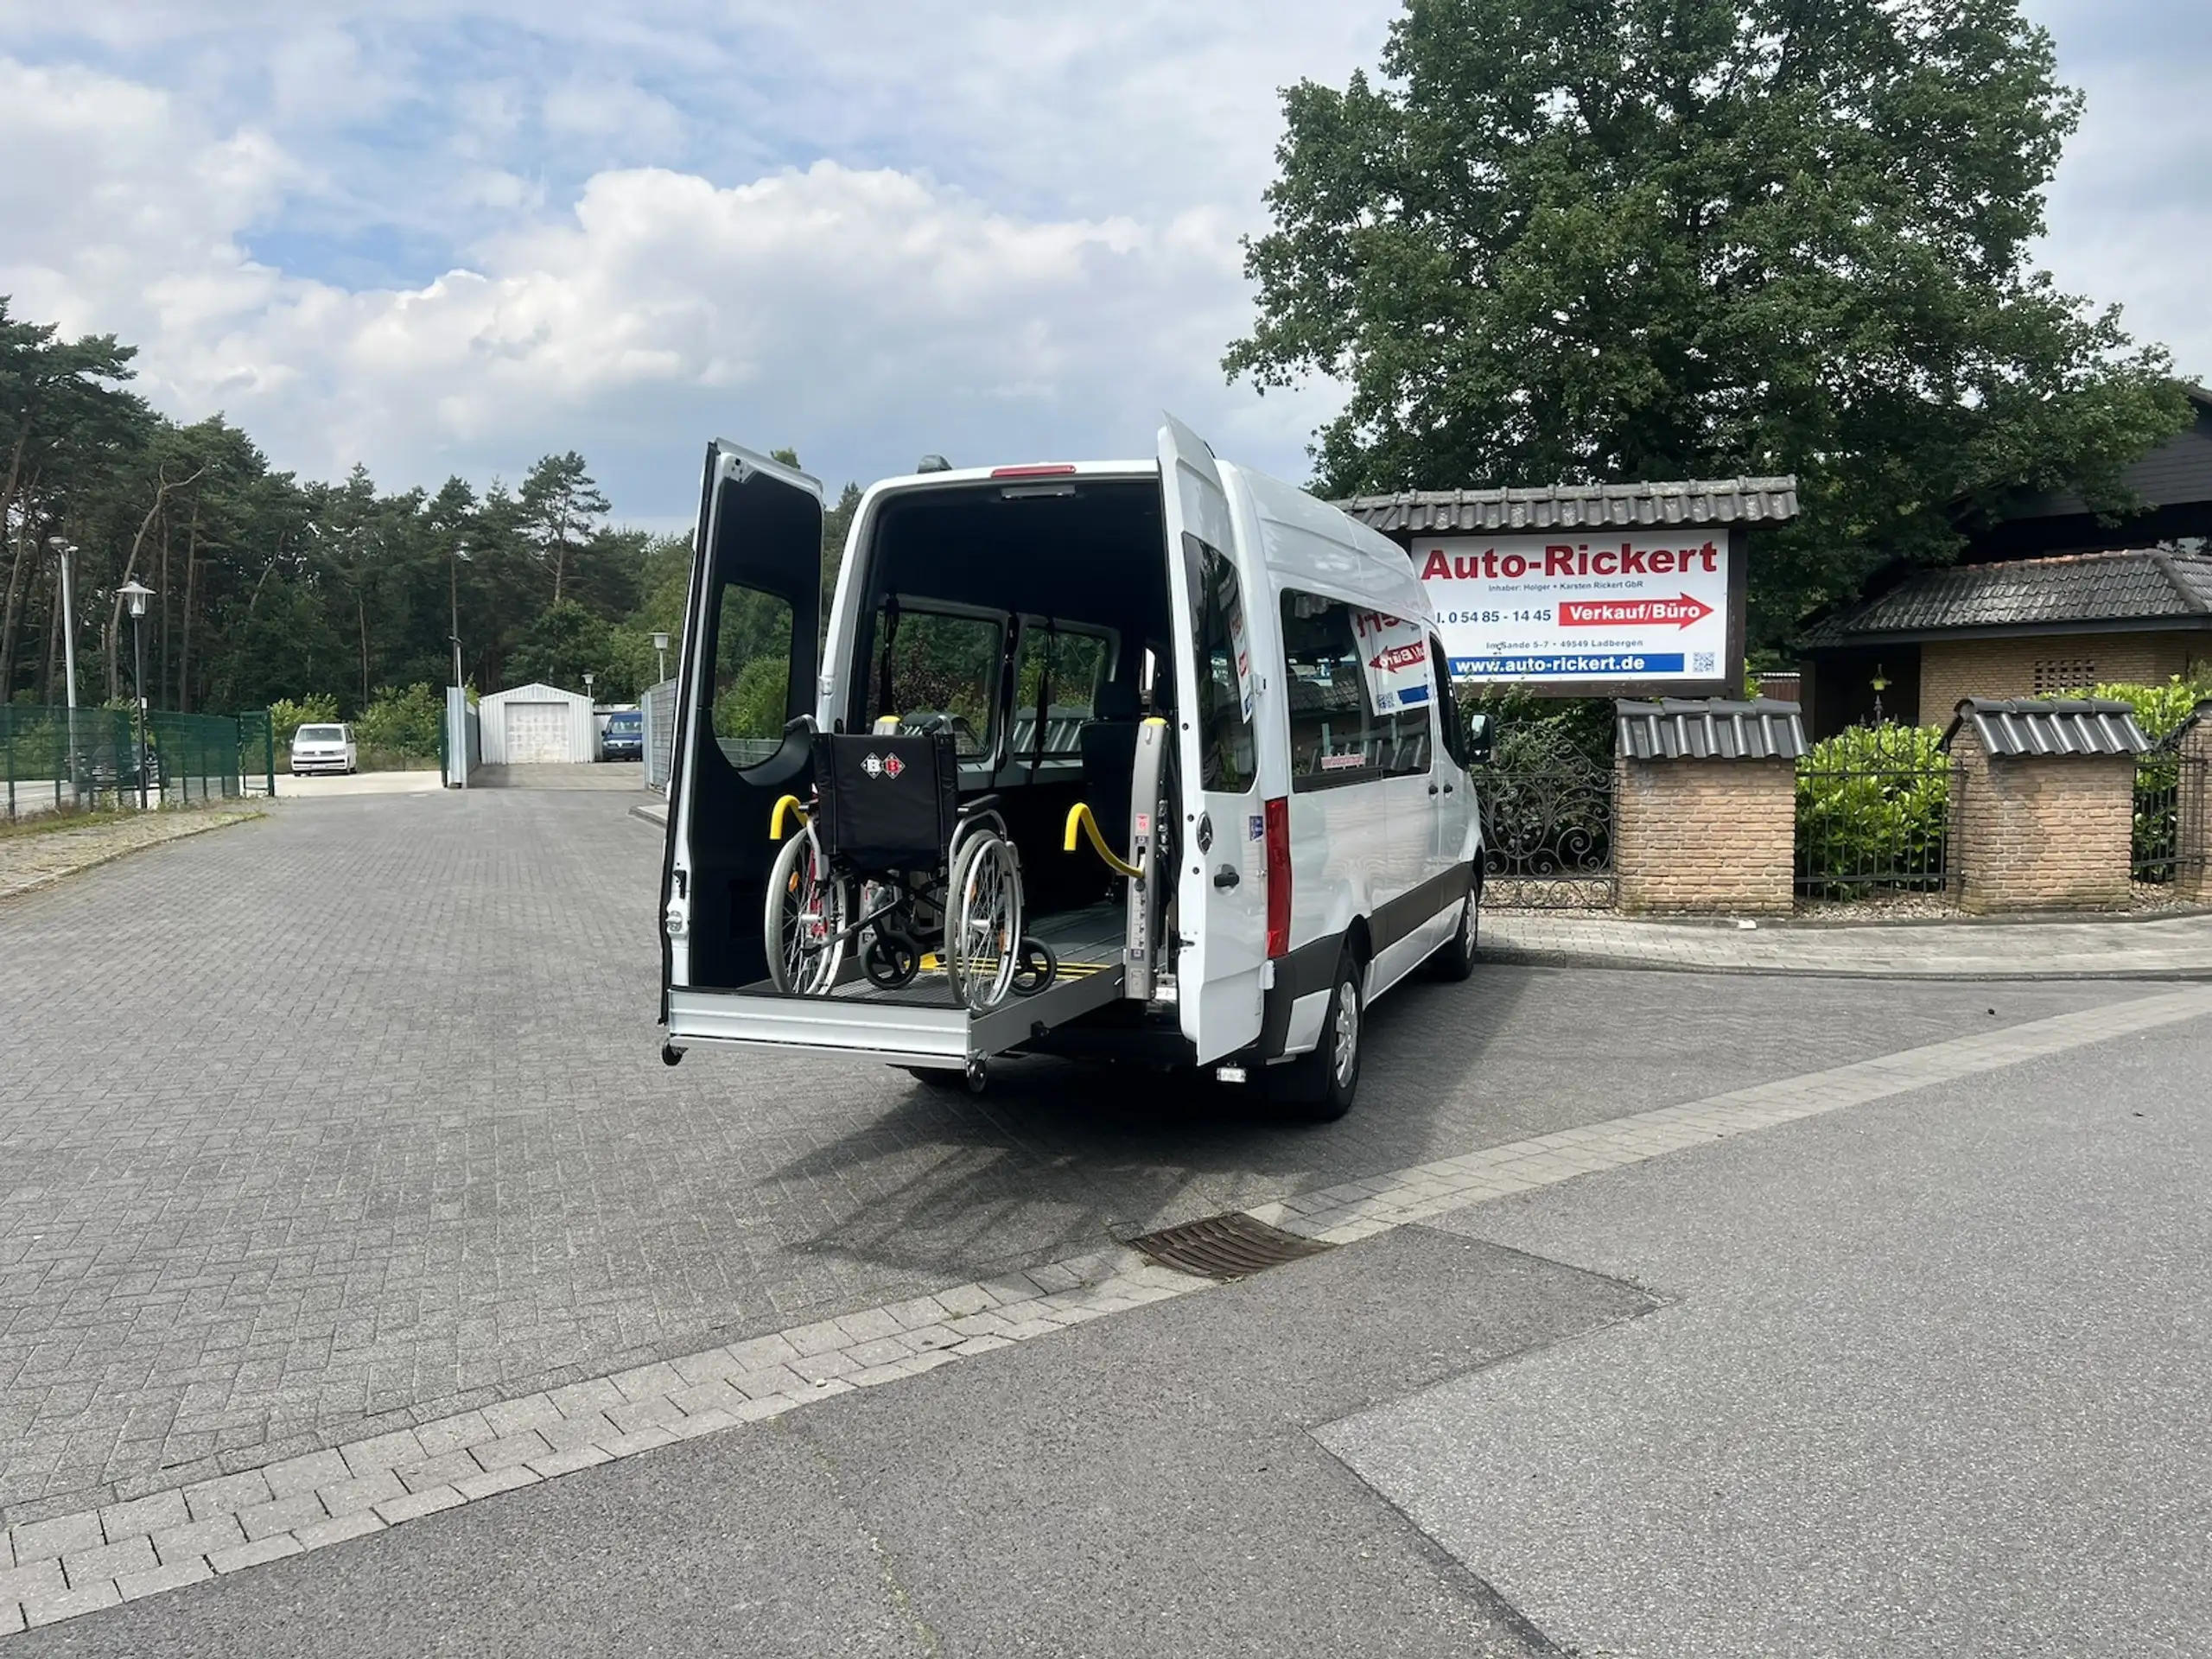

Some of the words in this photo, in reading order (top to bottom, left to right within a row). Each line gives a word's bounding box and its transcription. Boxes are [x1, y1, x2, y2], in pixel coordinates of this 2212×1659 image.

[1421, 541, 1718, 580] Auto-Rickert
[1523, 583, 1551, 592] Holger
[1593, 581, 1623, 589] Rickert
[1448, 612, 1458, 623] 0
[1461, 612, 1479, 623] 54
[1482, 611, 1500, 623] 85
[1513, 610, 1529, 622] 14
[1533, 609, 1552, 622] 45
[1569, 603, 1700, 620] Verkauf/Büro
[1591, 639, 1643, 648] Ladbergen
[1456, 655, 1645, 673] www.auto-rickert.de
